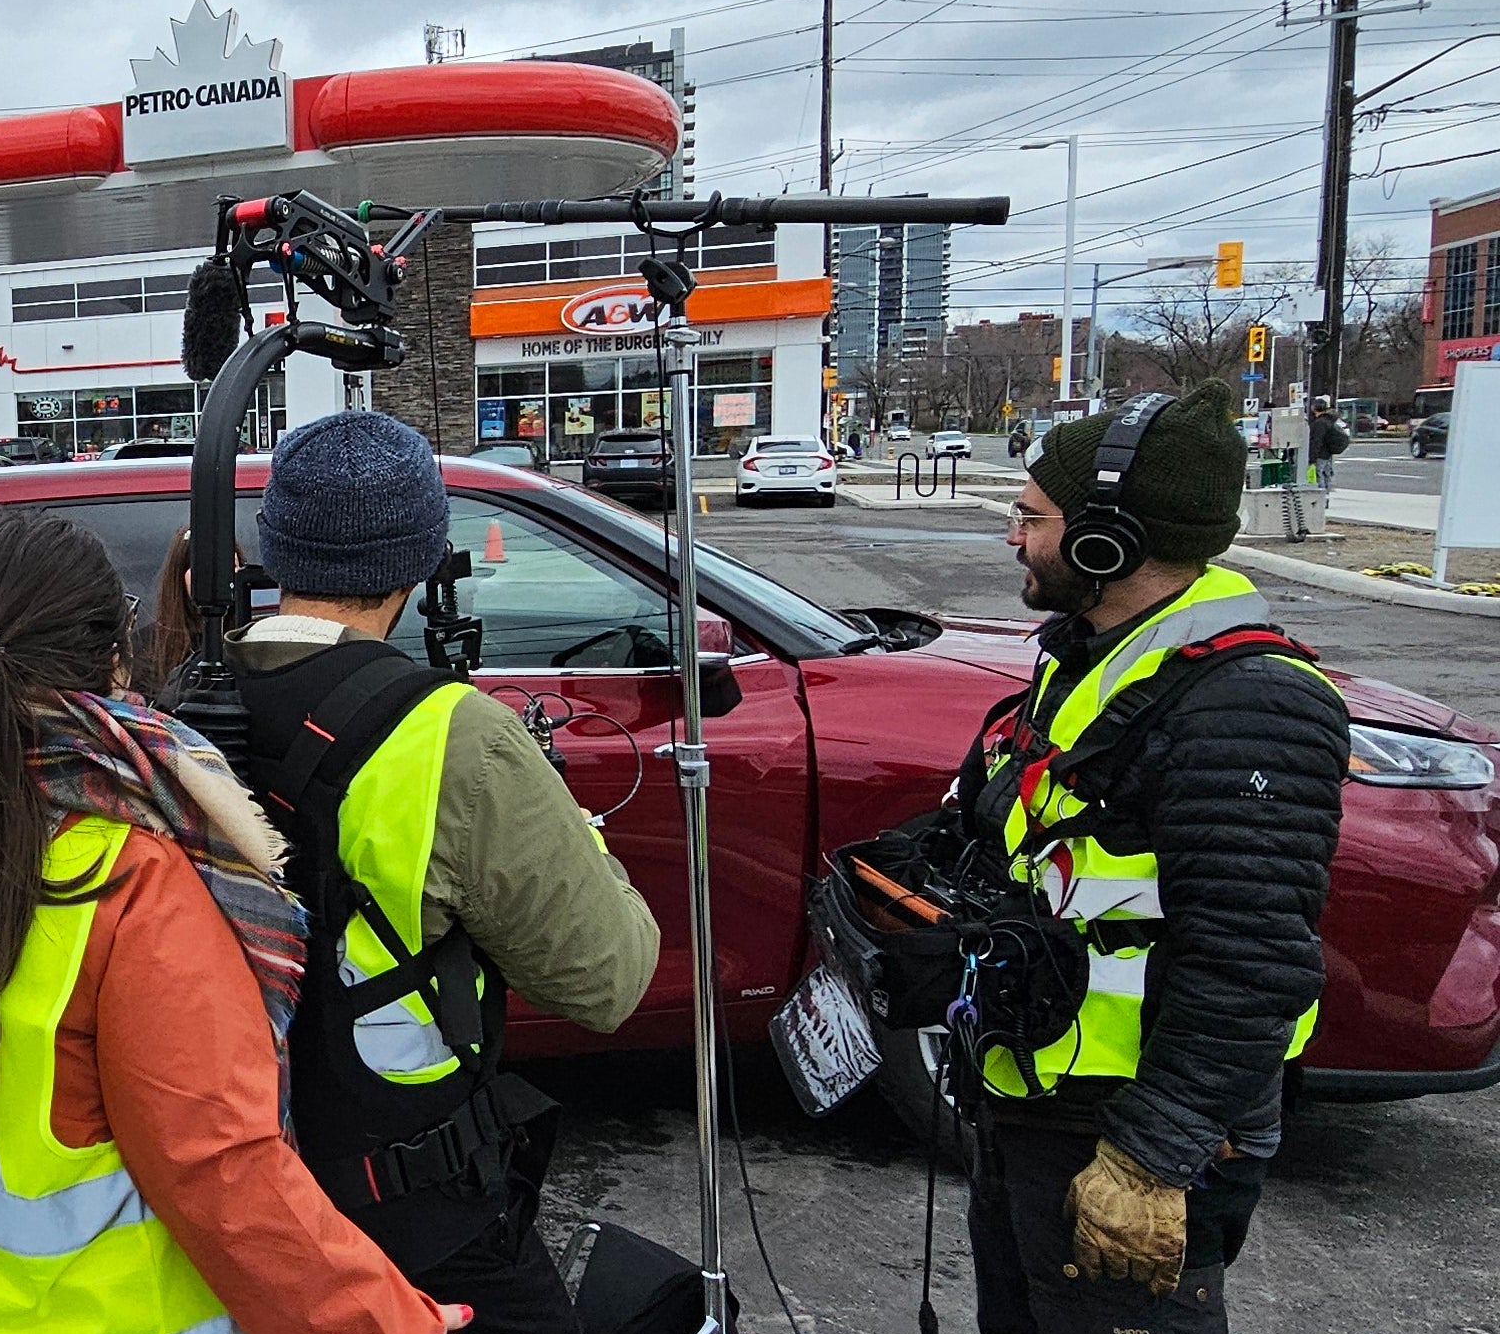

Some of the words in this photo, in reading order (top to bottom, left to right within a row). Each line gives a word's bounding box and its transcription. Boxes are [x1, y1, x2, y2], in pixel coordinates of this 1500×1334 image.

[125, 75, 282, 117] PETRO-CANADA
[578, 300, 667, 328] A&W
[522, 340, 560, 357] HOME
[563, 339, 582, 354] OF
[586, 336, 612, 353] THE
[1444, 345, 1491, 359] SHOPPERS
